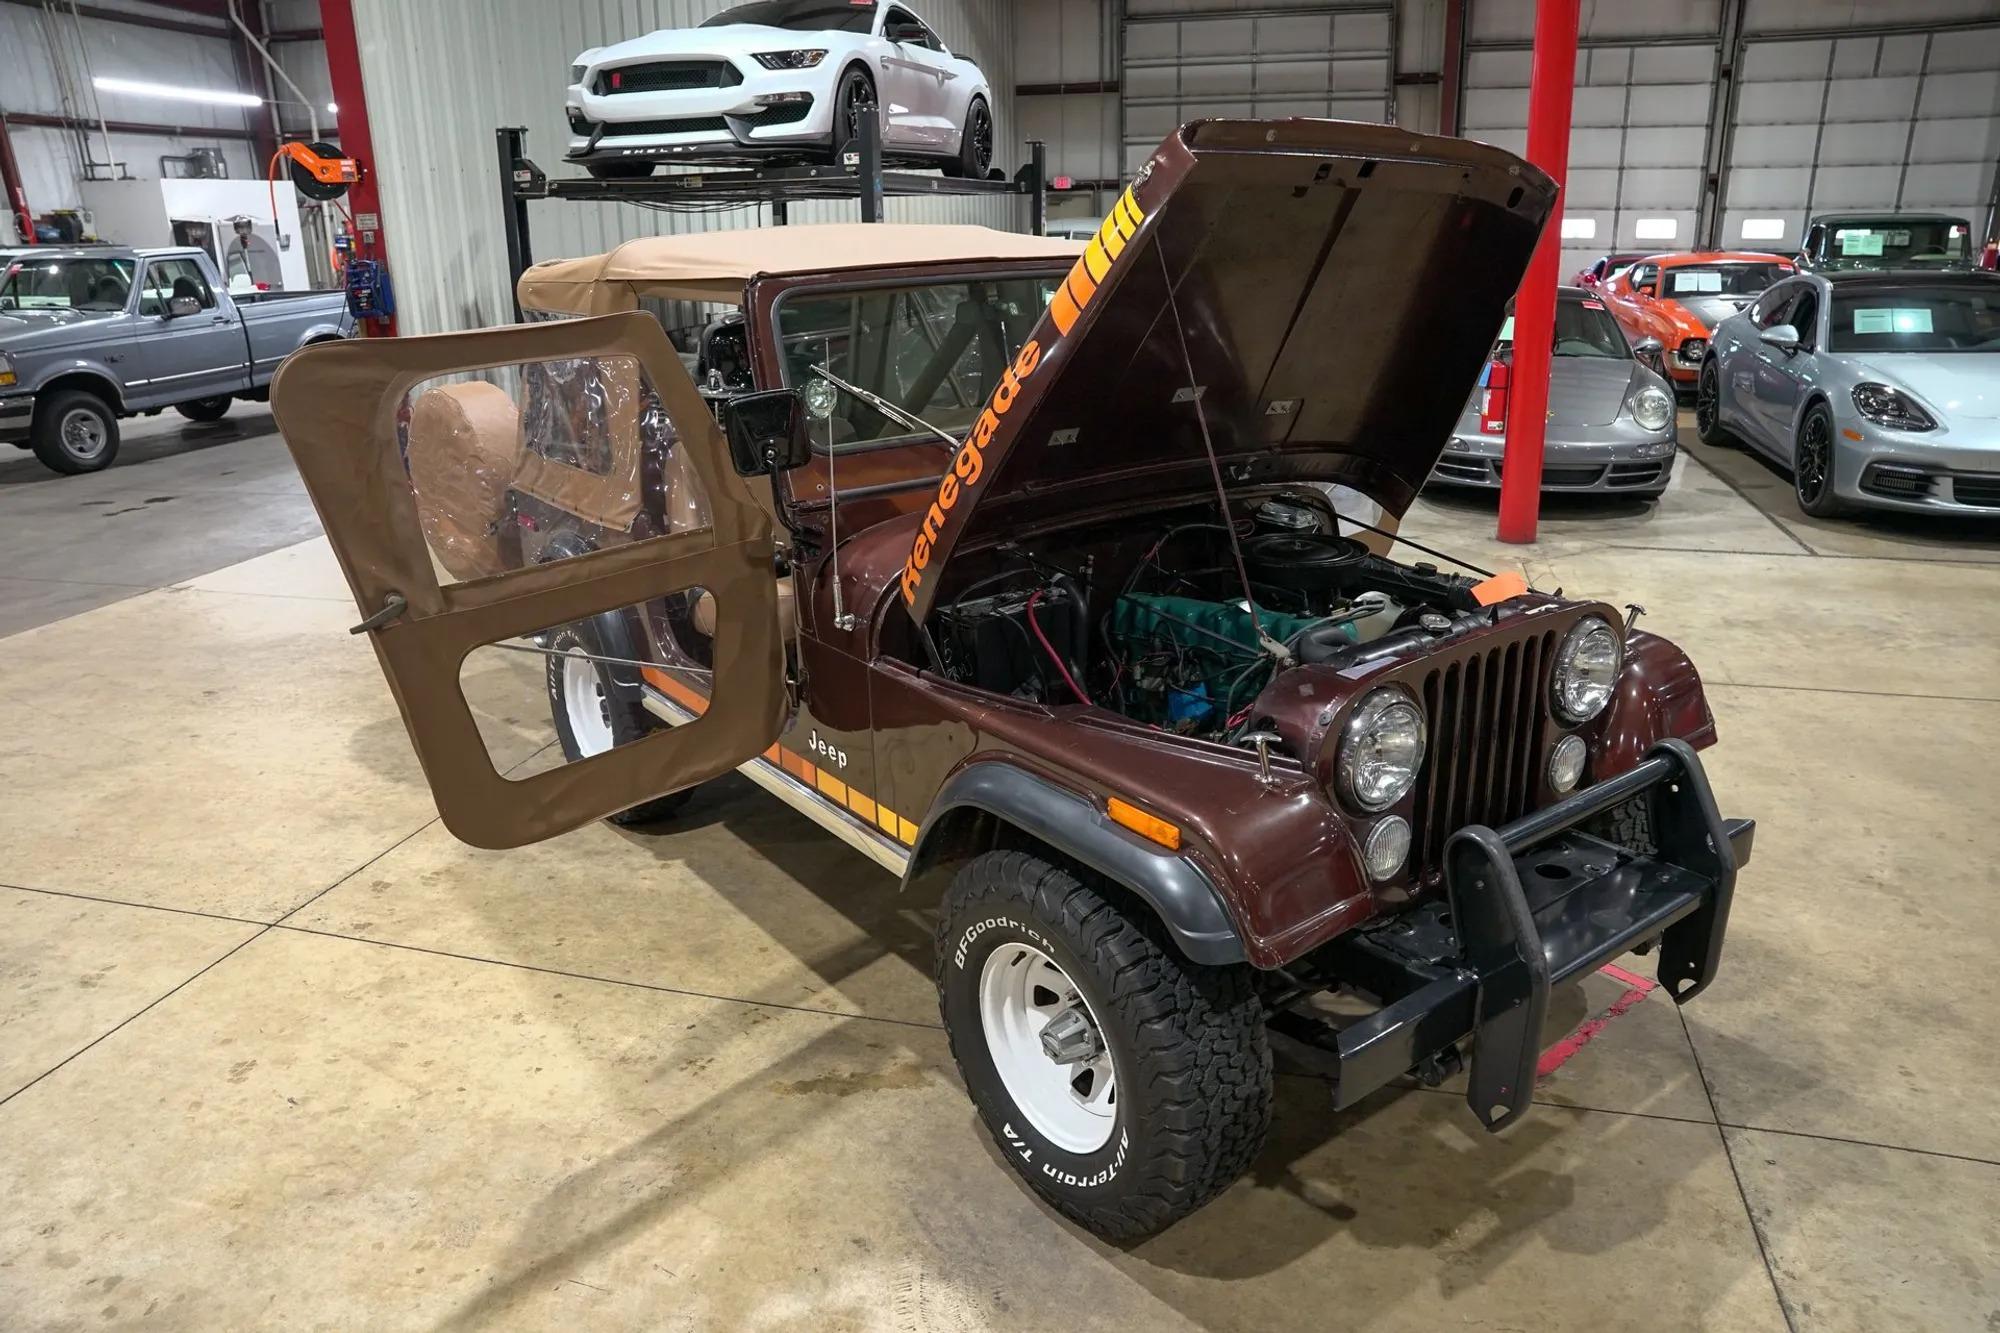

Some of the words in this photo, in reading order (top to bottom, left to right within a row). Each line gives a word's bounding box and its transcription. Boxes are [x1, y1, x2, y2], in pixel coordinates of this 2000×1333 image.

[901, 340, 1040, 606] Renegade
[808, 729, 847, 768] Jeep
[955, 917, 1055, 970] BFGoodrich
[1003, 1123, 1032, 1162] T/A
[1042, 1126, 1128, 1187] All-Terrain
